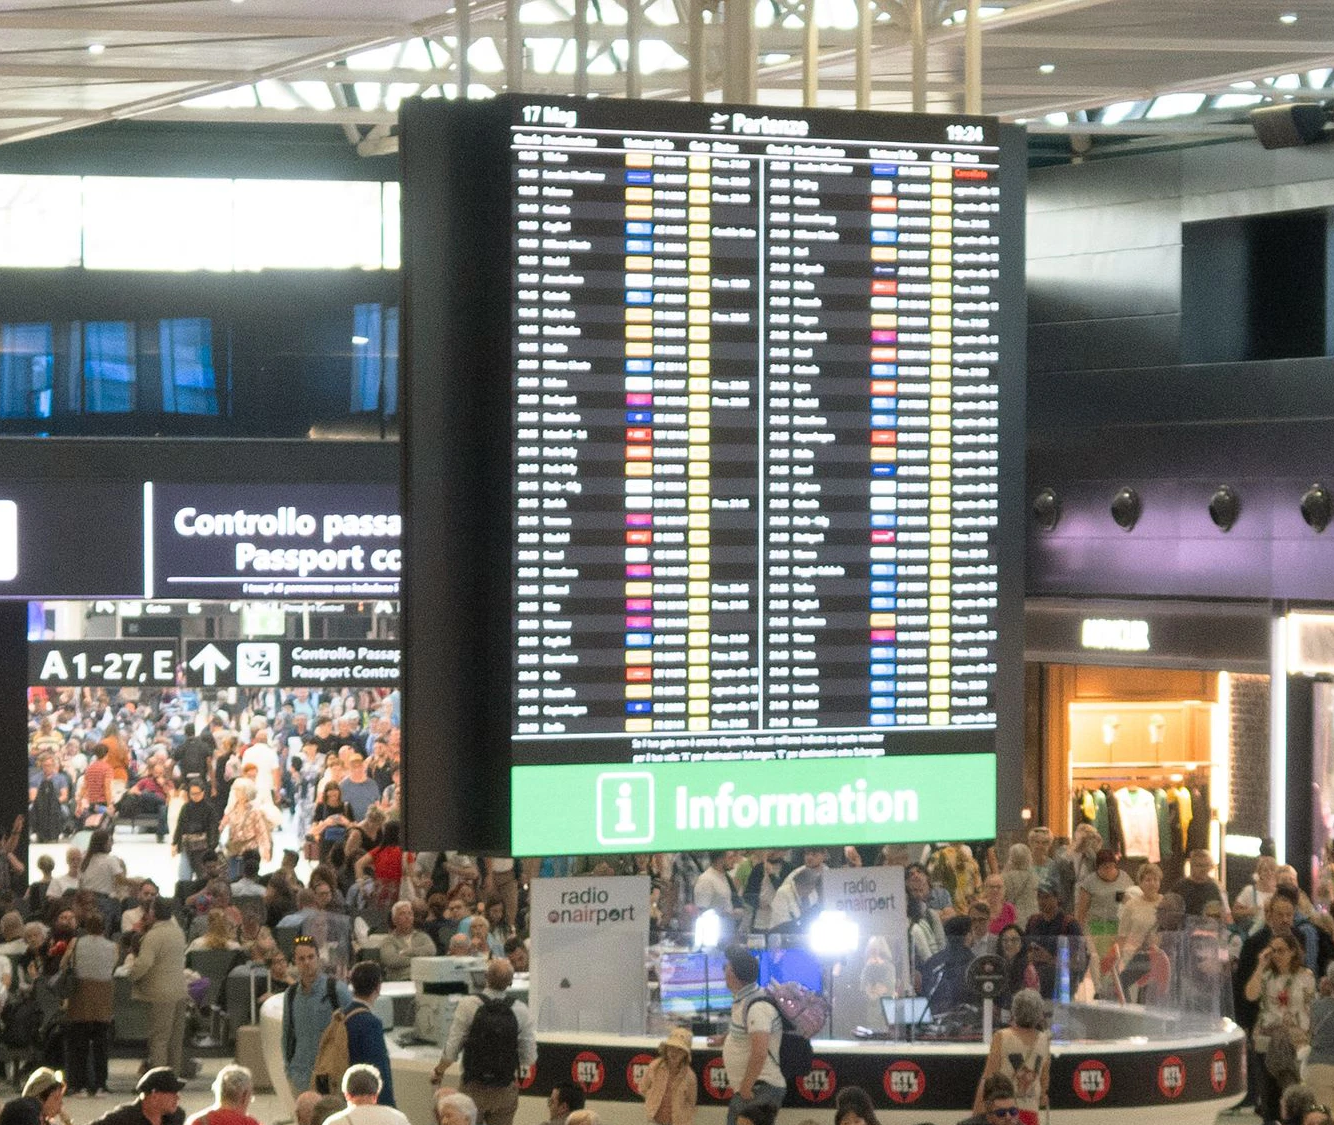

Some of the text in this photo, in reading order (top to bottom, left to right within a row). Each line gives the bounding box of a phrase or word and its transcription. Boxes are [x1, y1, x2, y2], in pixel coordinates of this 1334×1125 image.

[522, 105, 542, 122] 17
[733, 113, 809, 136] Partenze
[174, 506, 316, 537] Controllo
[236, 543, 364, 577] Passport
[291, 646, 355, 661] Controllo
[153, 650, 174, 680] E
[291, 665, 351, 682] Passport
[676, 779, 918, 830] Information
[560, 886, 609, 905] radio
[843, 877, 877, 895] radio
[547, 904, 636, 926] onairport
[577, 1061, 597, 1073] RTL
[890, 1071, 916, 1082] RTL
